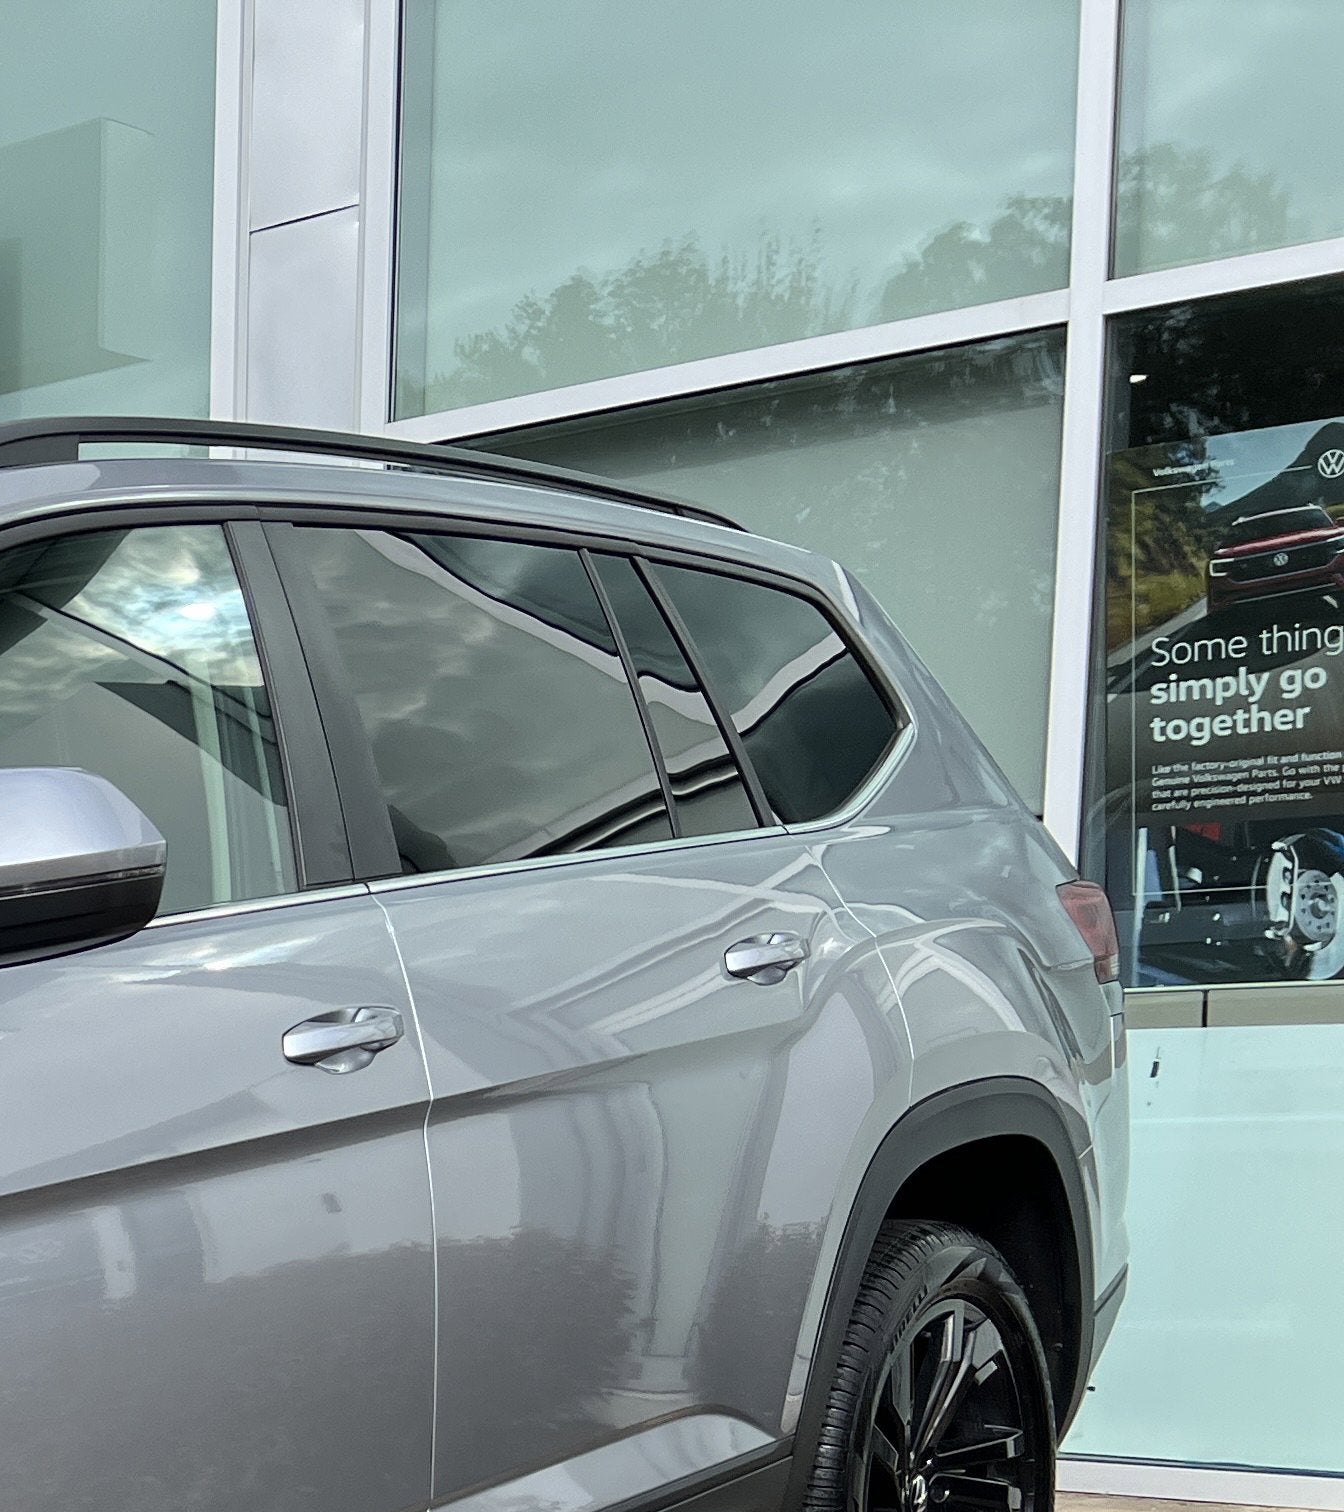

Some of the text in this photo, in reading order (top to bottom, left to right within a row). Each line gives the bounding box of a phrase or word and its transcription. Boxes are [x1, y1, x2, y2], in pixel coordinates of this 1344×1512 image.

[1318, 449, 1344, 478] VW
[1151, 636, 1248, 667] Some
[1150, 666, 1327, 706] simply go
[1150, 703, 1311, 746] together
[1173, 763, 1189, 772] the
[1280, 754, 1298, 763] and
[1301, 751, 1342, 761] function
[1152, 777, 1190, 787] Genuine
[1192, 772, 1250, 783] Volkswagen
[1282, 766, 1296, 776] Go
[1298, 765, 1320, 774] with
[1323, 764, 1340, 773] the
[1152, 790, 1171, 798] that
[1173, 789, 1189, 797] are
[1283, 779, 1297, 788] for
[1298, 778, 1321, 789] your
[1323, 775, 1342, 785] VW
[1152, 799, 1192, 811] carefully
[1193, 796, 1246, 809] engineered
